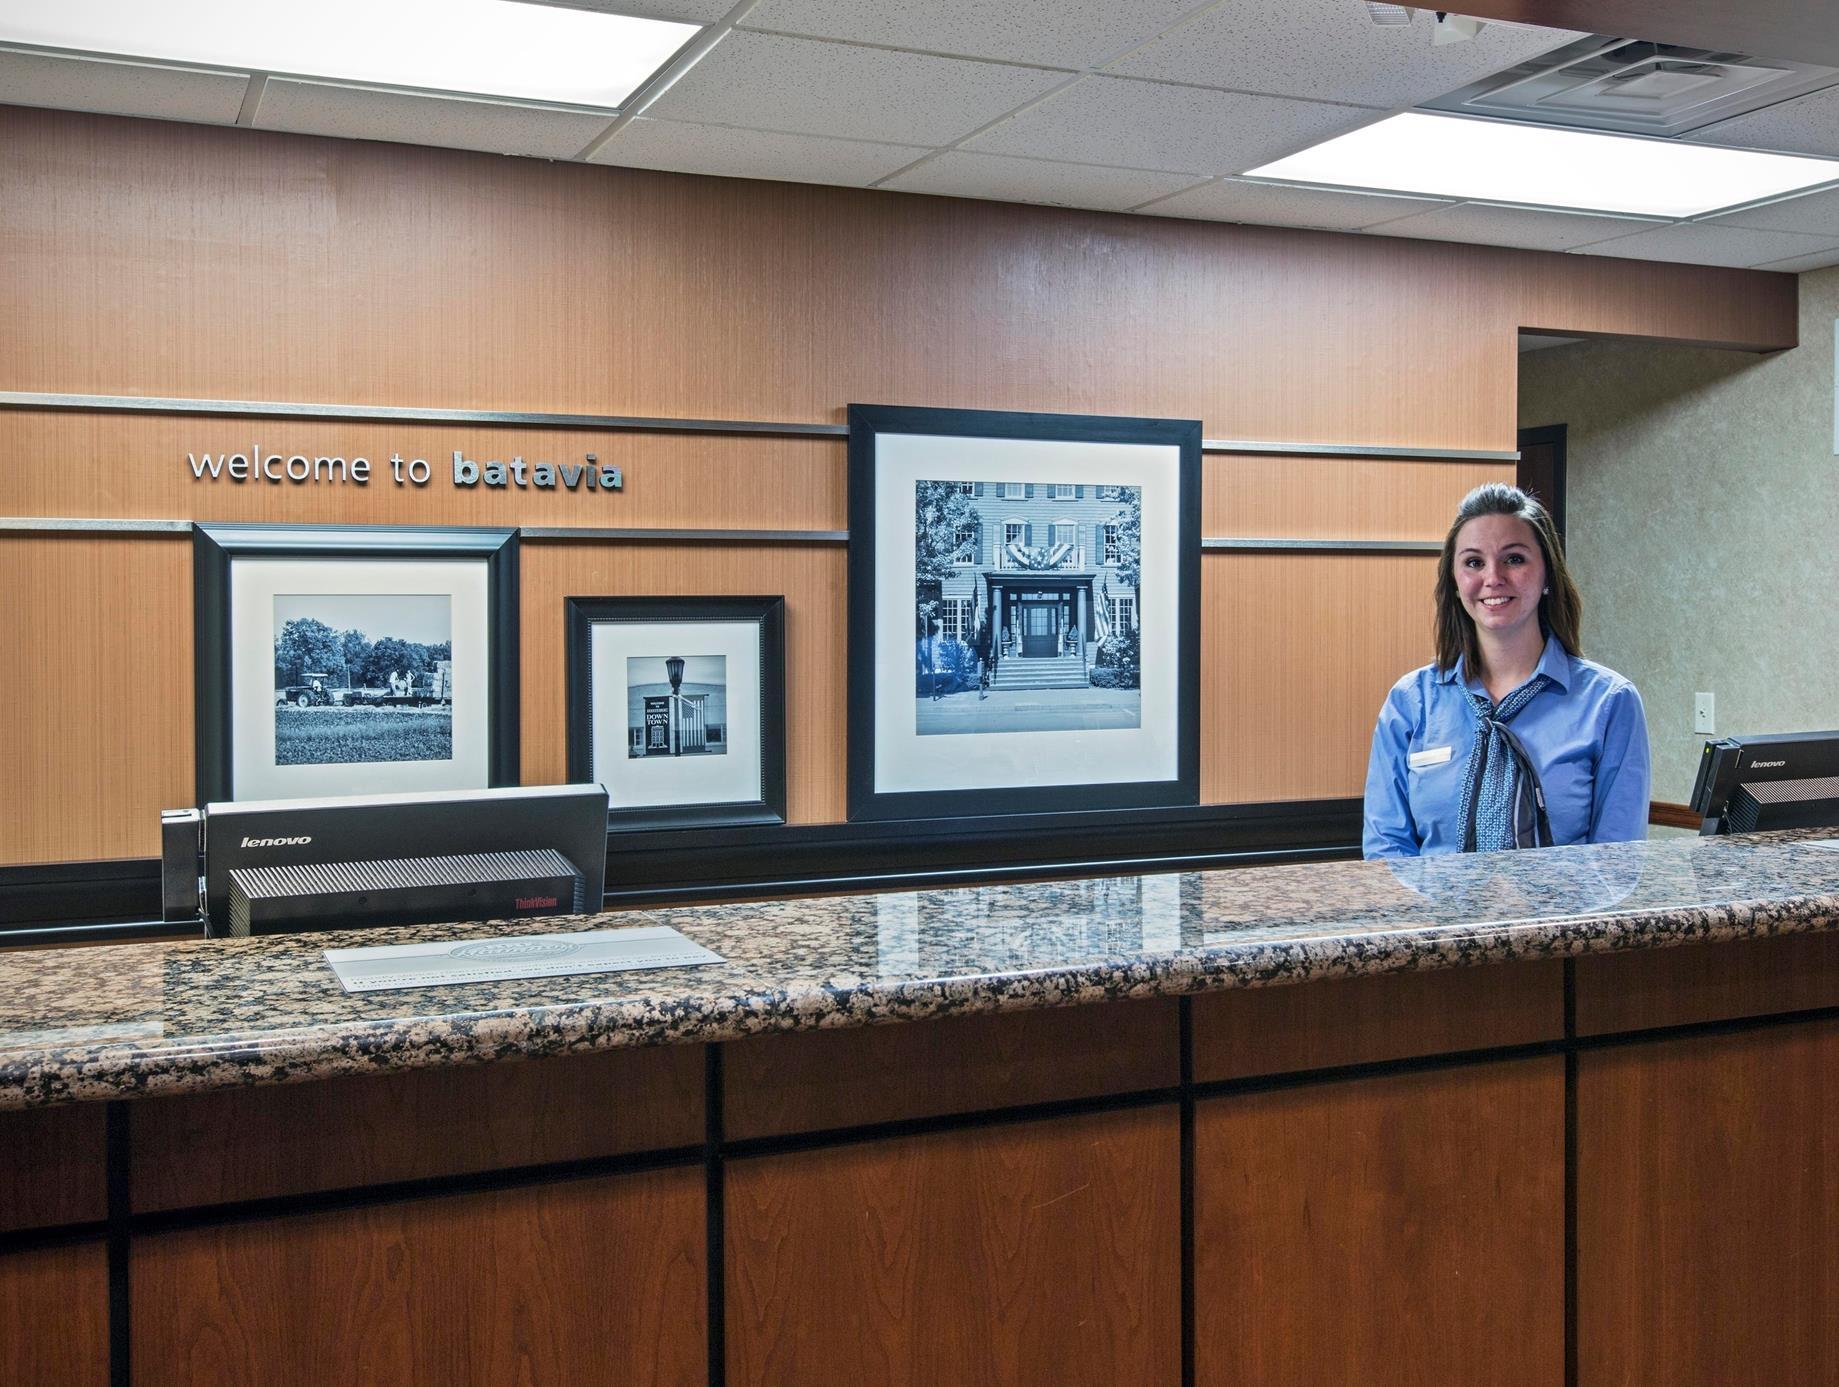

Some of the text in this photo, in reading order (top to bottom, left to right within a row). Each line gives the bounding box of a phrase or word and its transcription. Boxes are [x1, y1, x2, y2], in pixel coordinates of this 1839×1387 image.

[188, 444, 624, 490] welcome to batavia
[1750, 760, 1786, 769] lenovo
[240, 836, 312, 848] lenovo
[515, 896, 558, 910] ThinkVision
